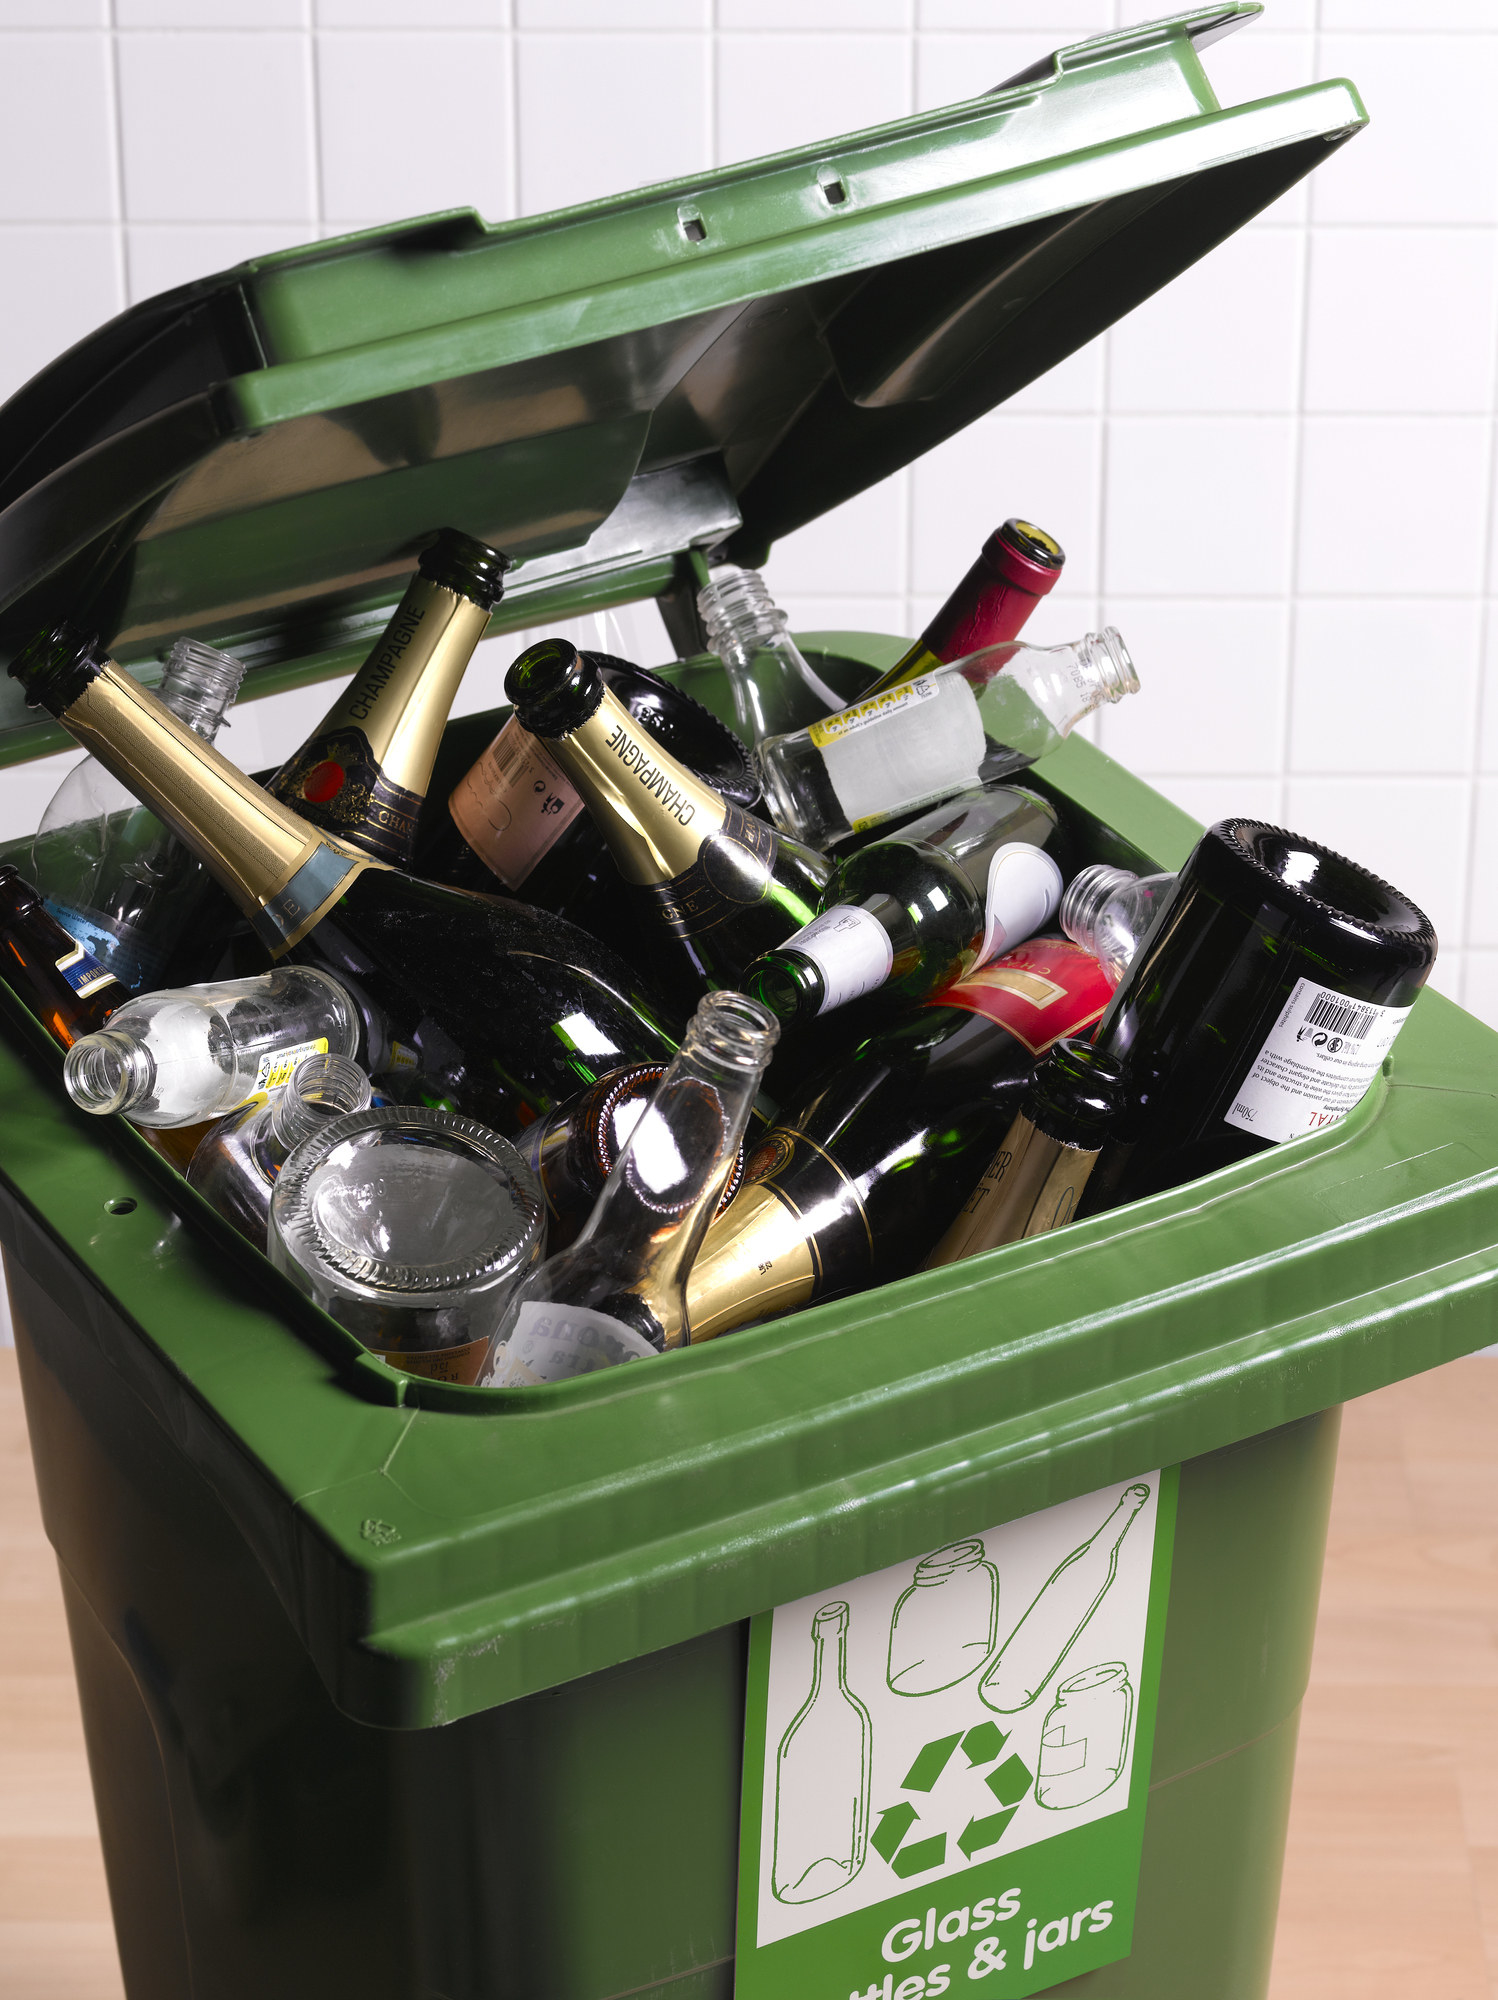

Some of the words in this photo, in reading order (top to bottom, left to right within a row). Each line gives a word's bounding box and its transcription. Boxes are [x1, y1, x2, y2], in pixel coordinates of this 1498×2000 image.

[348, 603, 425, 721] CHAMPAGNE
[605, 724, 695, 826] CHAMPAGNE
[1290, 982, 1305, 1004] contains
[1320, 991, 1349, 1007] 001000
[1278, 1005, 1294, 1027] sulphites
[1269, 1052, 1282, 1061] with
[1315, 1052, 1333, 1062] cellars.
[1256, 1064, 1264, 1072] its
[1260, 1057, 1287, 1073] character
[1265, 1068, 1276, 1076] and
[1283, 1058, 1316, 1073] assemblage
[1260, 1075, 1279, 1086] object
[1276, 1073, 1302, 1086] structure
[1288, 1069, 1309, 1080] elegant
[1280, 1083, 1289, 1091] the
[1302, 1091, 1322, 1099] passion
[1231, 1102, 1257, 1121] 750ml
[881, 1887, 1021, 1963] Glass
[967, 1936, 1007, 1980] &
[1023, 1900, 1114, 1970] jars
